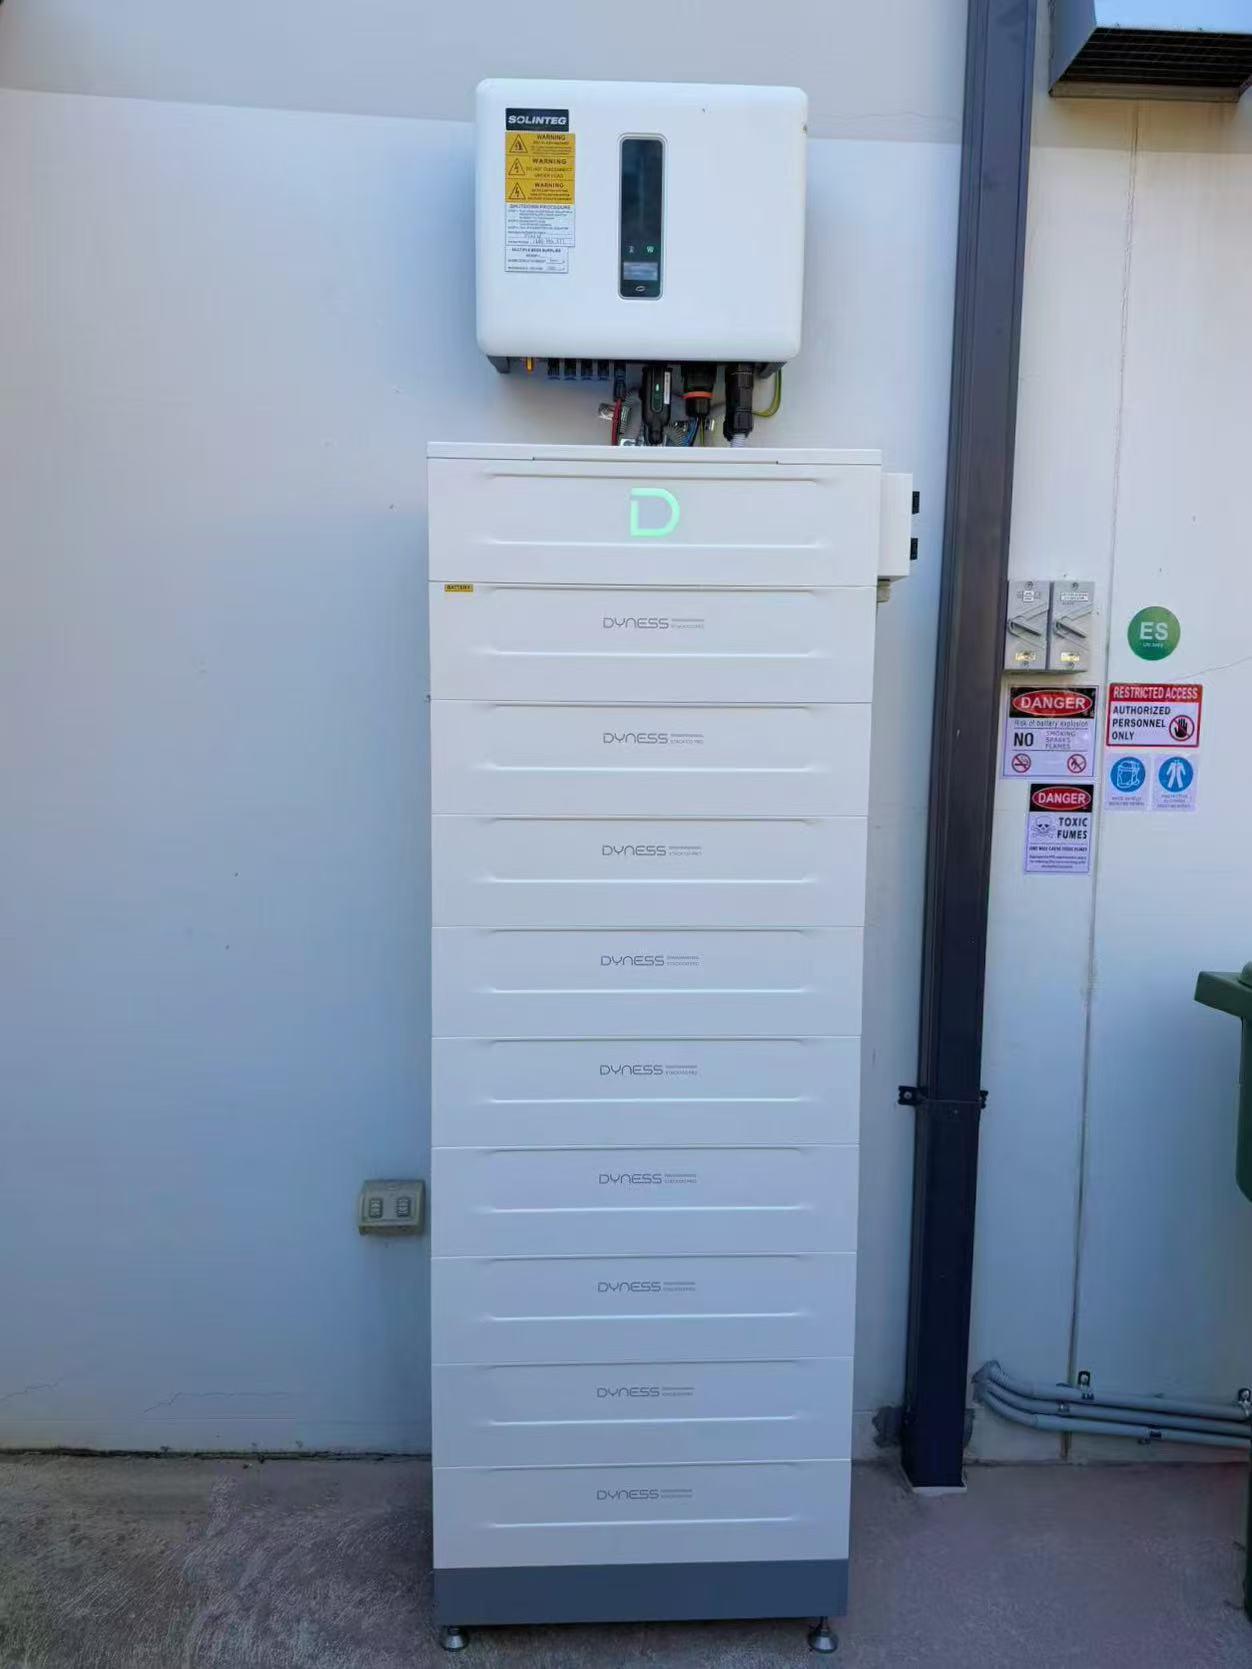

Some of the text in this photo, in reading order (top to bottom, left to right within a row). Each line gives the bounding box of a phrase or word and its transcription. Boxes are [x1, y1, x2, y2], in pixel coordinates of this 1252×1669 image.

[508, 115, 567, 125] SOLINTEG
[603, 618, 669, 629] DYNESS
[1140, 622, 1168, 641] ES
[1113, 687, 1198, 699] RESTRICTED ACCESS
[1020, 696, 1086, 709] DANGER
[1113, 706, 1171, 715] AUTHORIZED
[1037, 720, 1058, 728] battery
[1060, 720, 1088, 728] explosion
[1112, 719, 1166, 728] PERSONNEL
[603, 733, 668, 744] DYNESS
[1013, 732, 1034, 747] NO
[1112, 731, 1135, 740] ONLY
[1038, 793, 1086, 804] DANGER
[1058, 817, 1088, 827] TOXIC
[1057, 830, 1088, 839] FUMES
[602, 845, 666, 856] DYNESS
[601, 955, 664, 966] DYNESS
[599, 1064, 663, 1075] DYNESS
[599, 1173, 662, 1184] DYNESS
[598, 1281, 661, 1292] DYNESS
[597, 1387, 660, 1398] DYNESS
[597, 1489, 659, 1500] DYNESS
